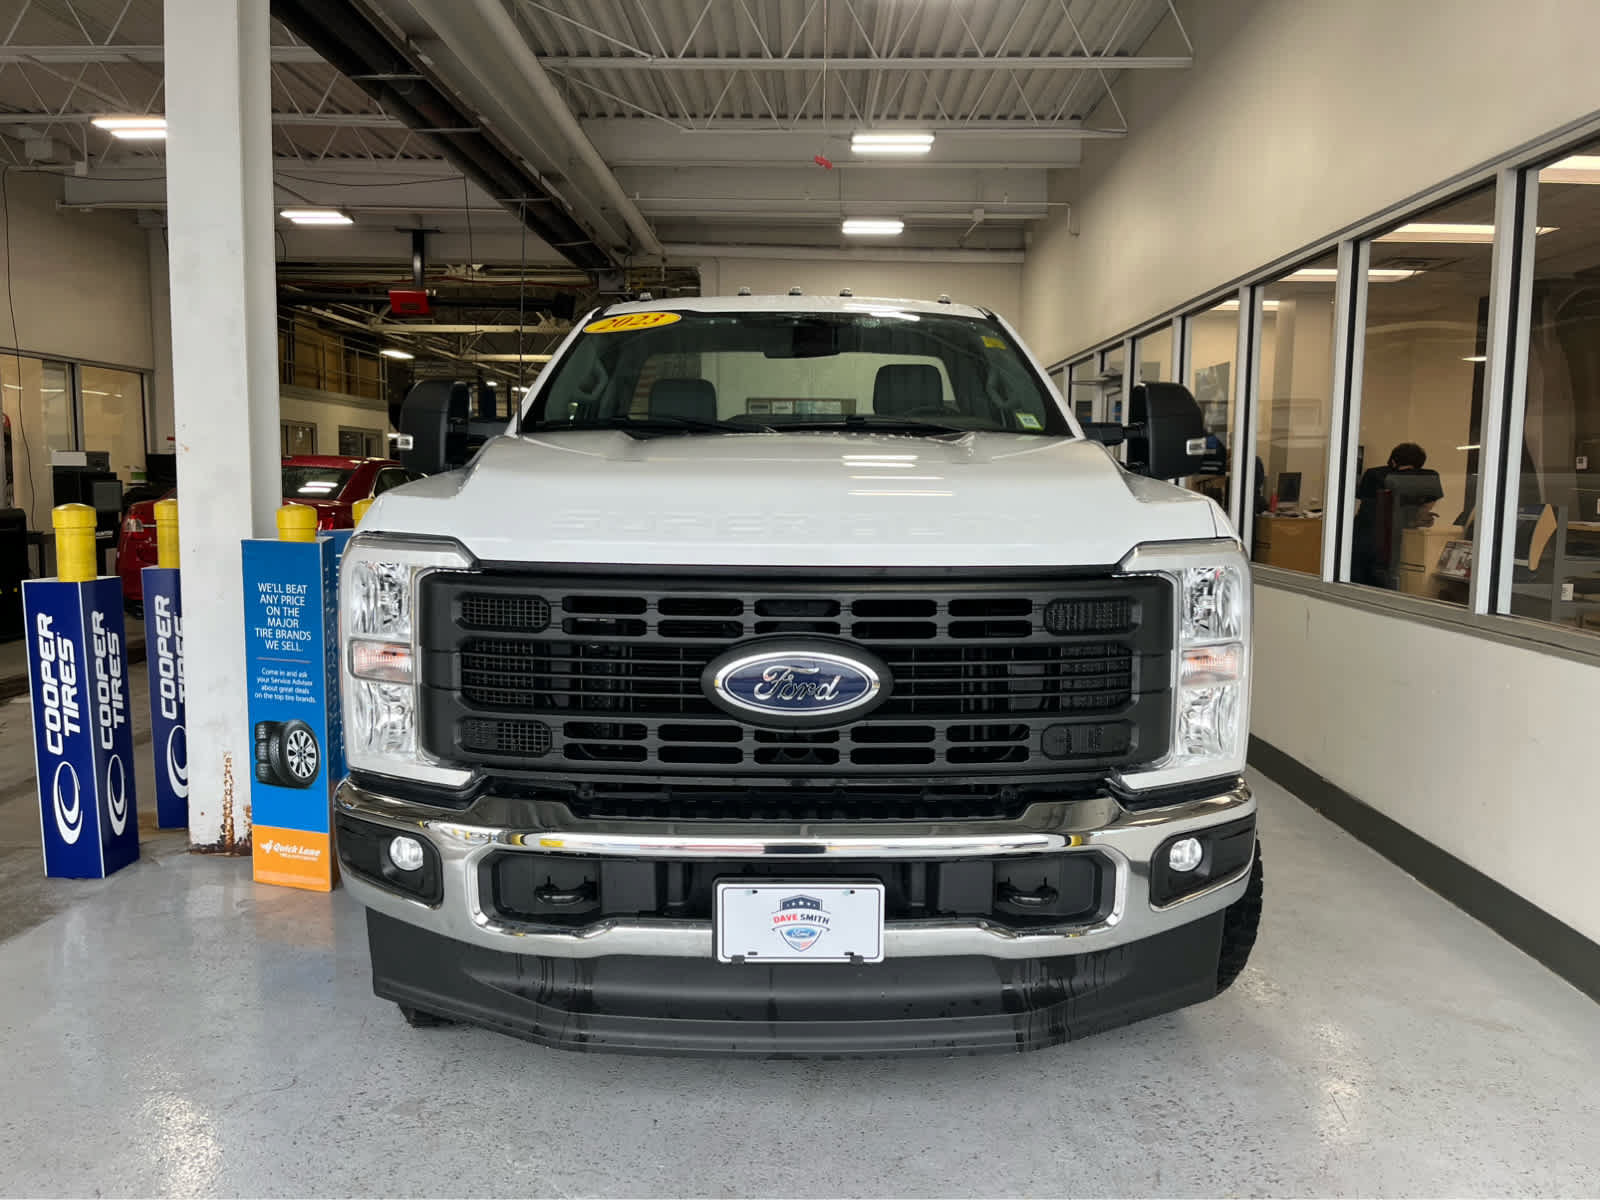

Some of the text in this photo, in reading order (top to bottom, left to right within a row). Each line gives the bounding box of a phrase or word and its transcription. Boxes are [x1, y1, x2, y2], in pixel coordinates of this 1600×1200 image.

[596, 314, 666, 331] 2023
[257, 582, 307, 594] WE'LL BEAT
[260, 594, 305, 606] ANY PRICE
[266, 605, 300, 617] ON THE
[267, 617, 299, 628] MAJOR
[254, 627, 312, 640] TIRE BRANDS
[265, 640, 304, 652] WE SELL.
[155, 595, 177, 720] COOPER
[261, 667, 278, 676] Come
[286, 669, 297, 677] and
[36, 612, 63, 756] COOPER
[91, 611, 113, 750] COOPER
[107, 631, 125, 729] TIRES
[754, 665, 842, 701] Ford
[56, 636, 81, 737] TIRES
[261, 684, 278, 692] about
[263, 692, 273, 700] the
[273, 843, 298, 855] Quick
[299, 845, 321, 857] Lane
[773, 913, 830, 925] DAVE SMITH
